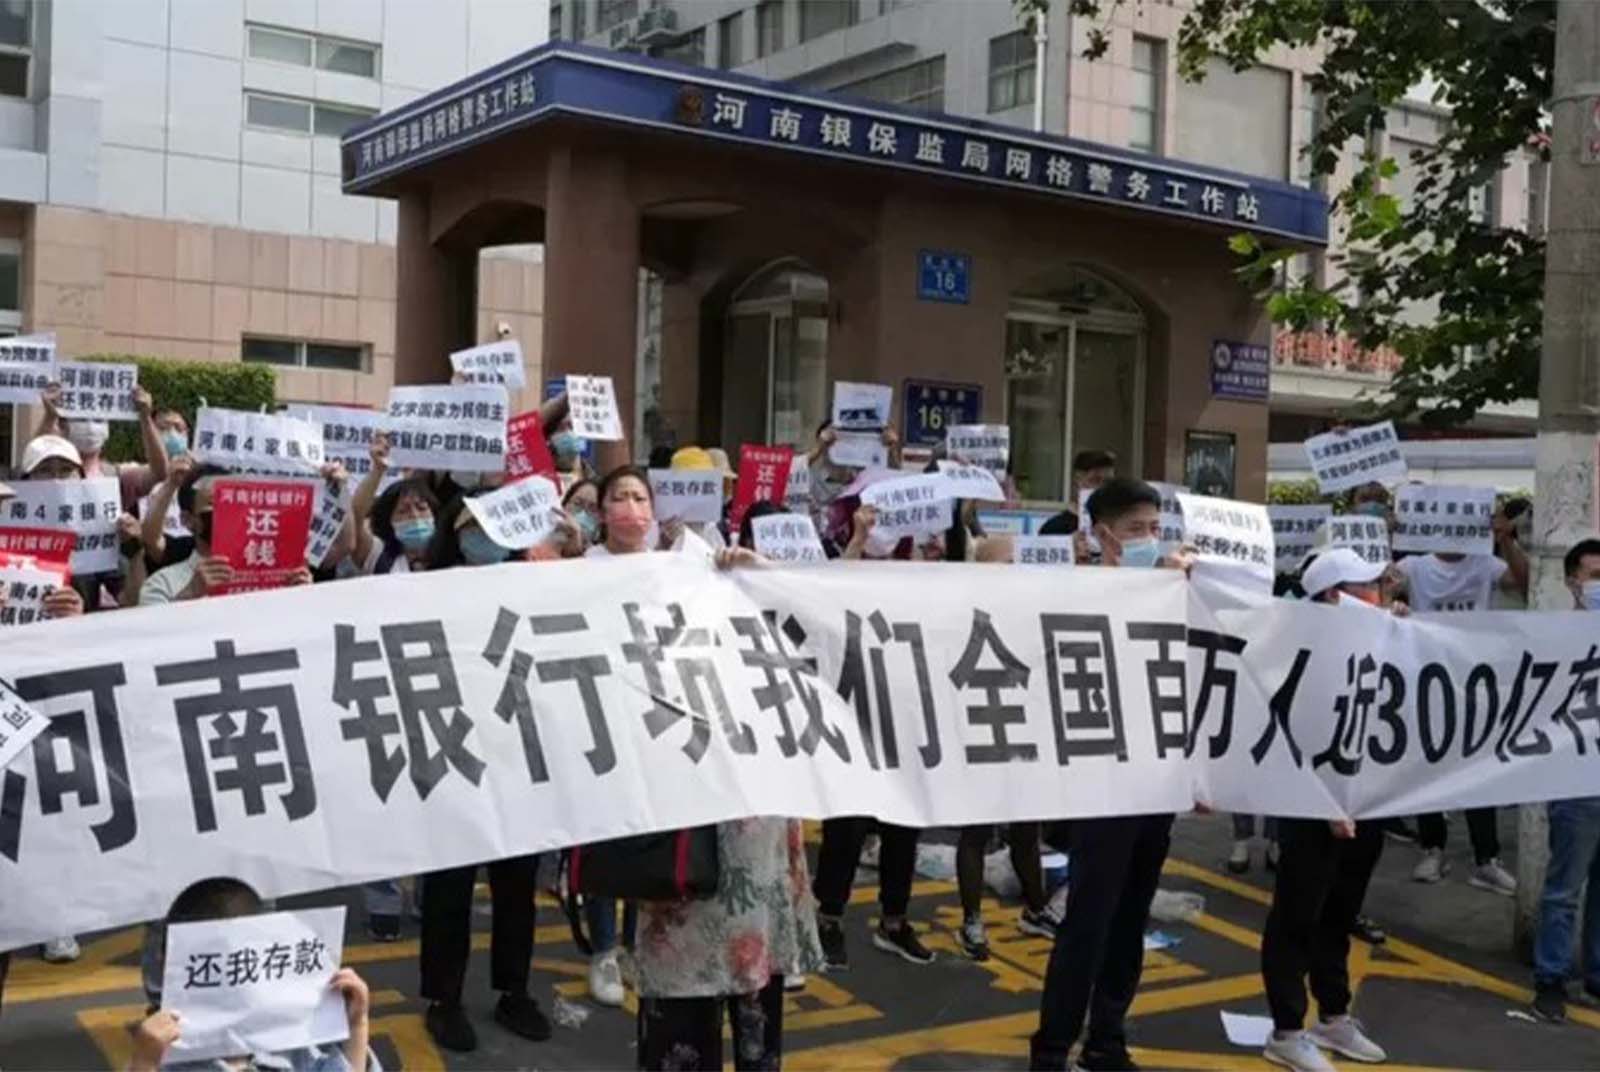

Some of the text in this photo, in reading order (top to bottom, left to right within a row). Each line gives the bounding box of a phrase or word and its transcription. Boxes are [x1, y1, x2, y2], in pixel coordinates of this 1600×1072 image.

[362, 71, 536, 169] 河南银保监局网格警务工作站
[713, 92, 1260, 223] 河南银保监局网格警务工作站
[60, 367, 134, 391] 河南银行
[918, 405, 942, 430] 16
[199, 430, 320, 460] 河南4家银行
[655, 480, 718, 497] 还我存款
[878, 505, 941, 527] 还我存款
[1193, 533, 1268, 564] 还我存款
[184, 938, 325, 990] 还我存款
